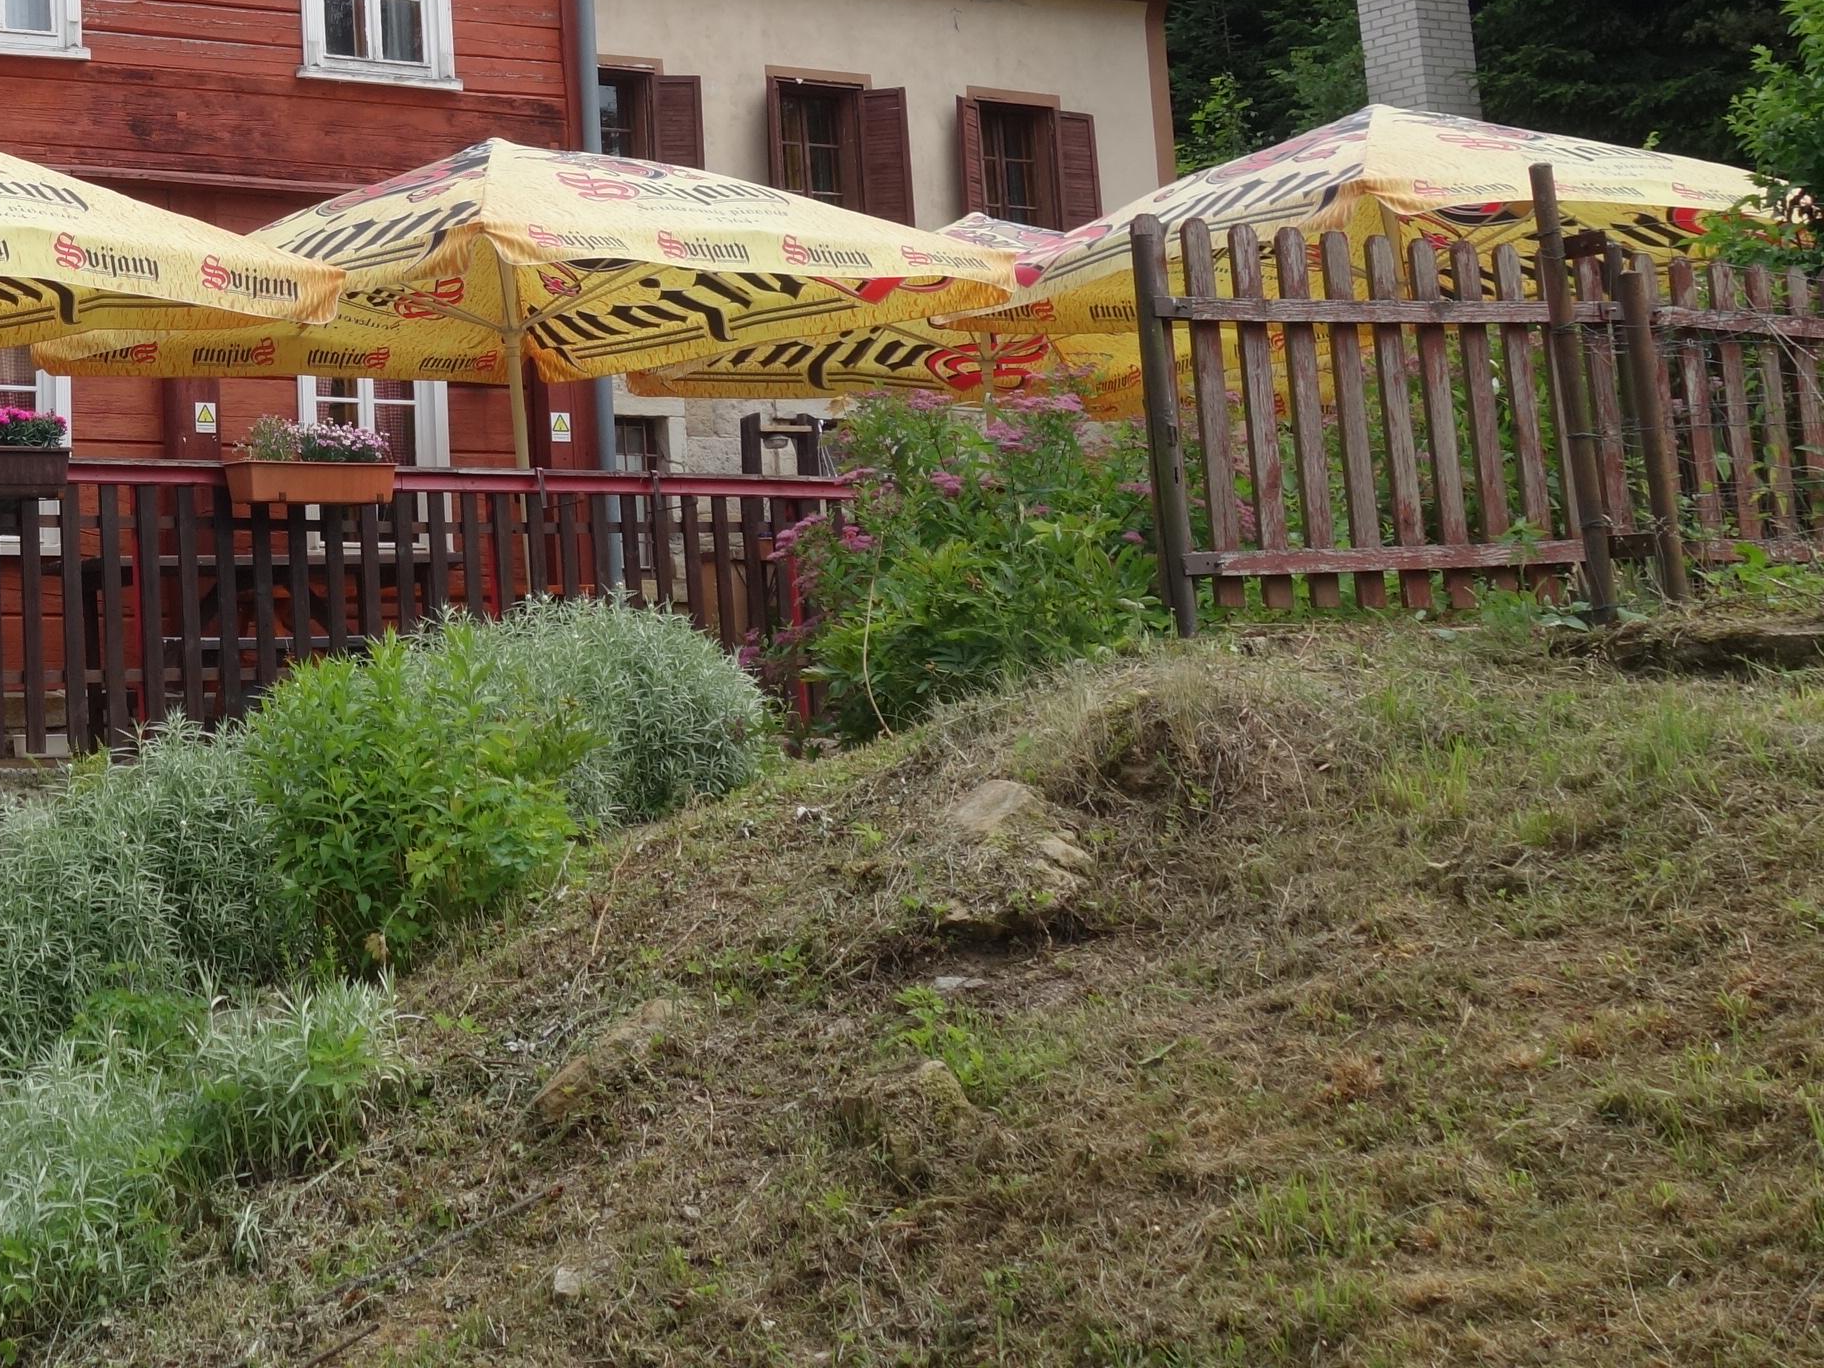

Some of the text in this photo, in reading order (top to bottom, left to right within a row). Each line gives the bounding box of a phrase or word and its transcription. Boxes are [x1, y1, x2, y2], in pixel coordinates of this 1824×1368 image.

[555, 172, 791, 205] Svijany
[528, 224, 629, 251] Svijany
[657, 230, 750, 263] Svijany
[782, 234, 873, 268] Svijany
[53, 232, 159, 281] Svijany
[901, 244, 991, 270] Svijany
[200, 254, 299, 302] Svijany
